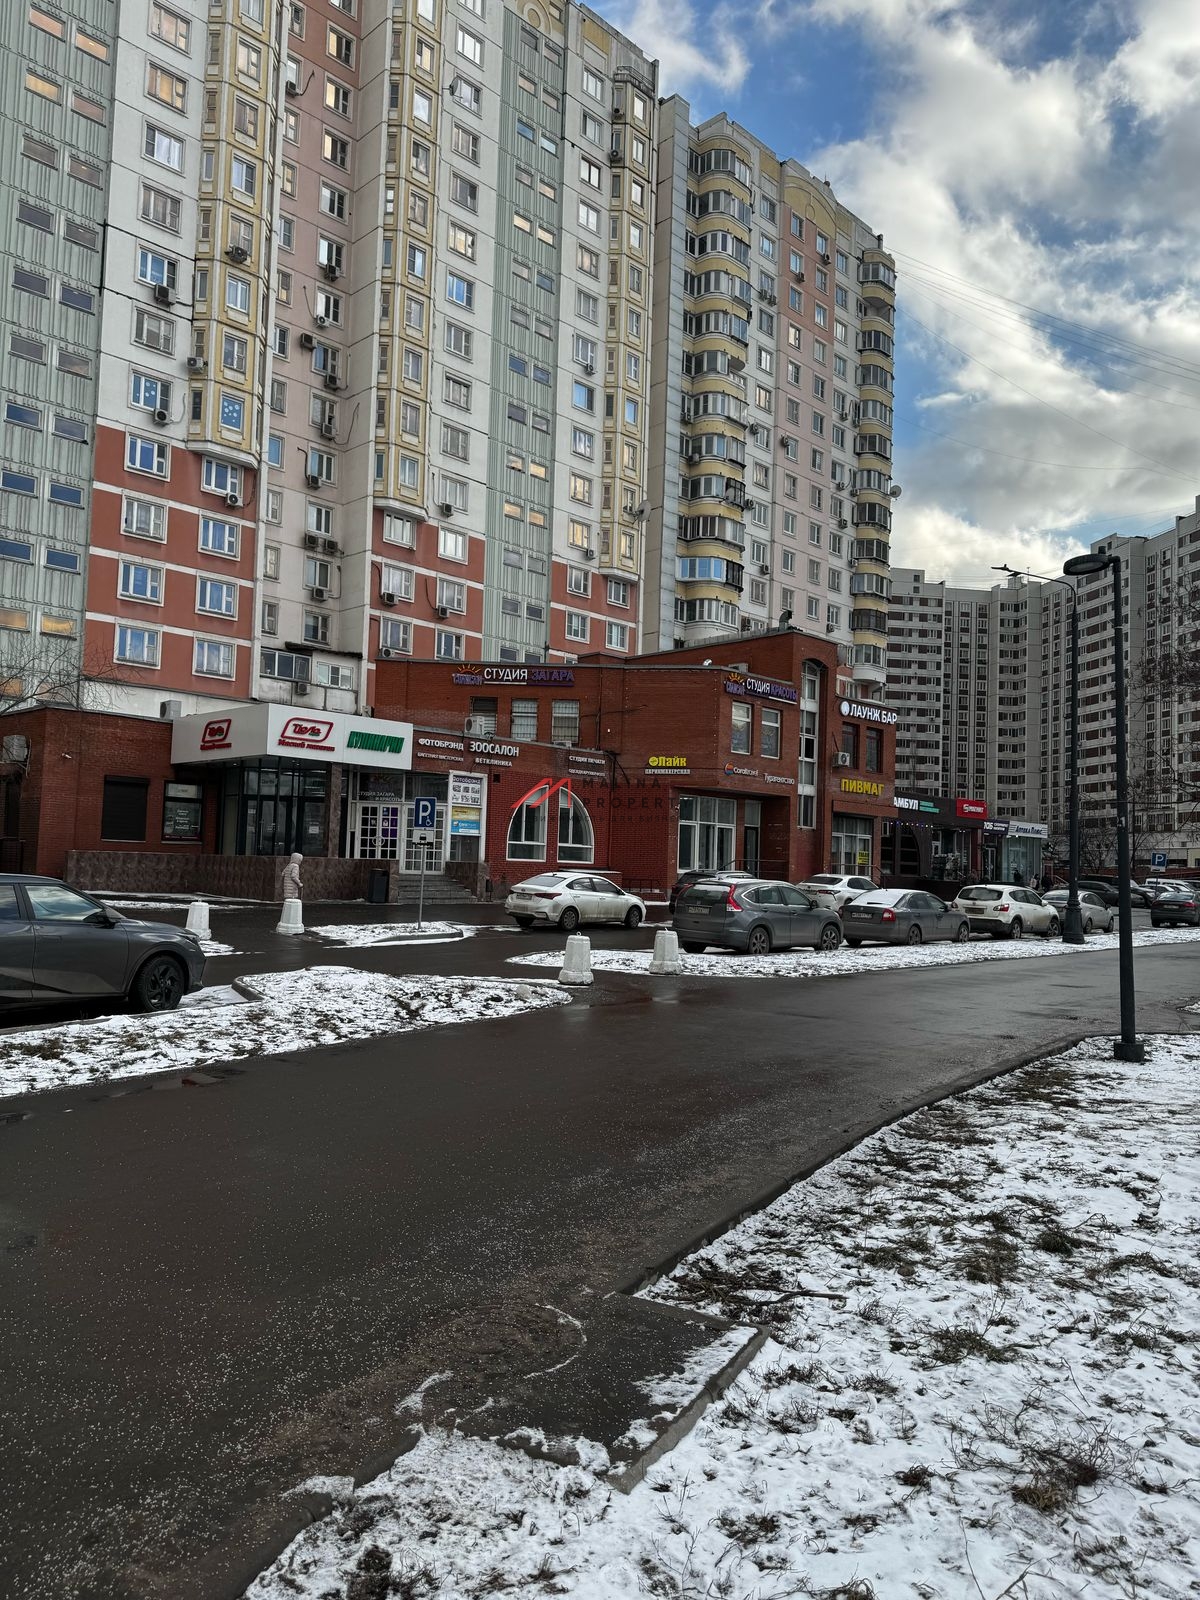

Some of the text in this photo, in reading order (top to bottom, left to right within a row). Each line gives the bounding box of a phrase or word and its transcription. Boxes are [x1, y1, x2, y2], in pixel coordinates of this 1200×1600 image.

[484, 667, 528, 681] СТУДИЯ
[531, 669, 575, 682] ЗАГАРА
[746, 678, 770, 694] СТУДИЯ
[770, 684, 798, 700] КРАСОТЫ
[849, 704, 898, 725] ЛАУНЖ БАР
[278, 739, 306, 748] Мясной
[347, 731, 405, 753] КУЛИНАРИЯ
[418, 738, 464, 751] ФОТОБРЭНД
[469, 741, 520, 757] ЗООСАЛОН
[475, 757, 513, 767] ВЕТКЛИНИКА
[841, 778, 885, 796] ПИВМАГ
[418, 800, 431, 825] P
[1155, 854, 1164, 865] P
